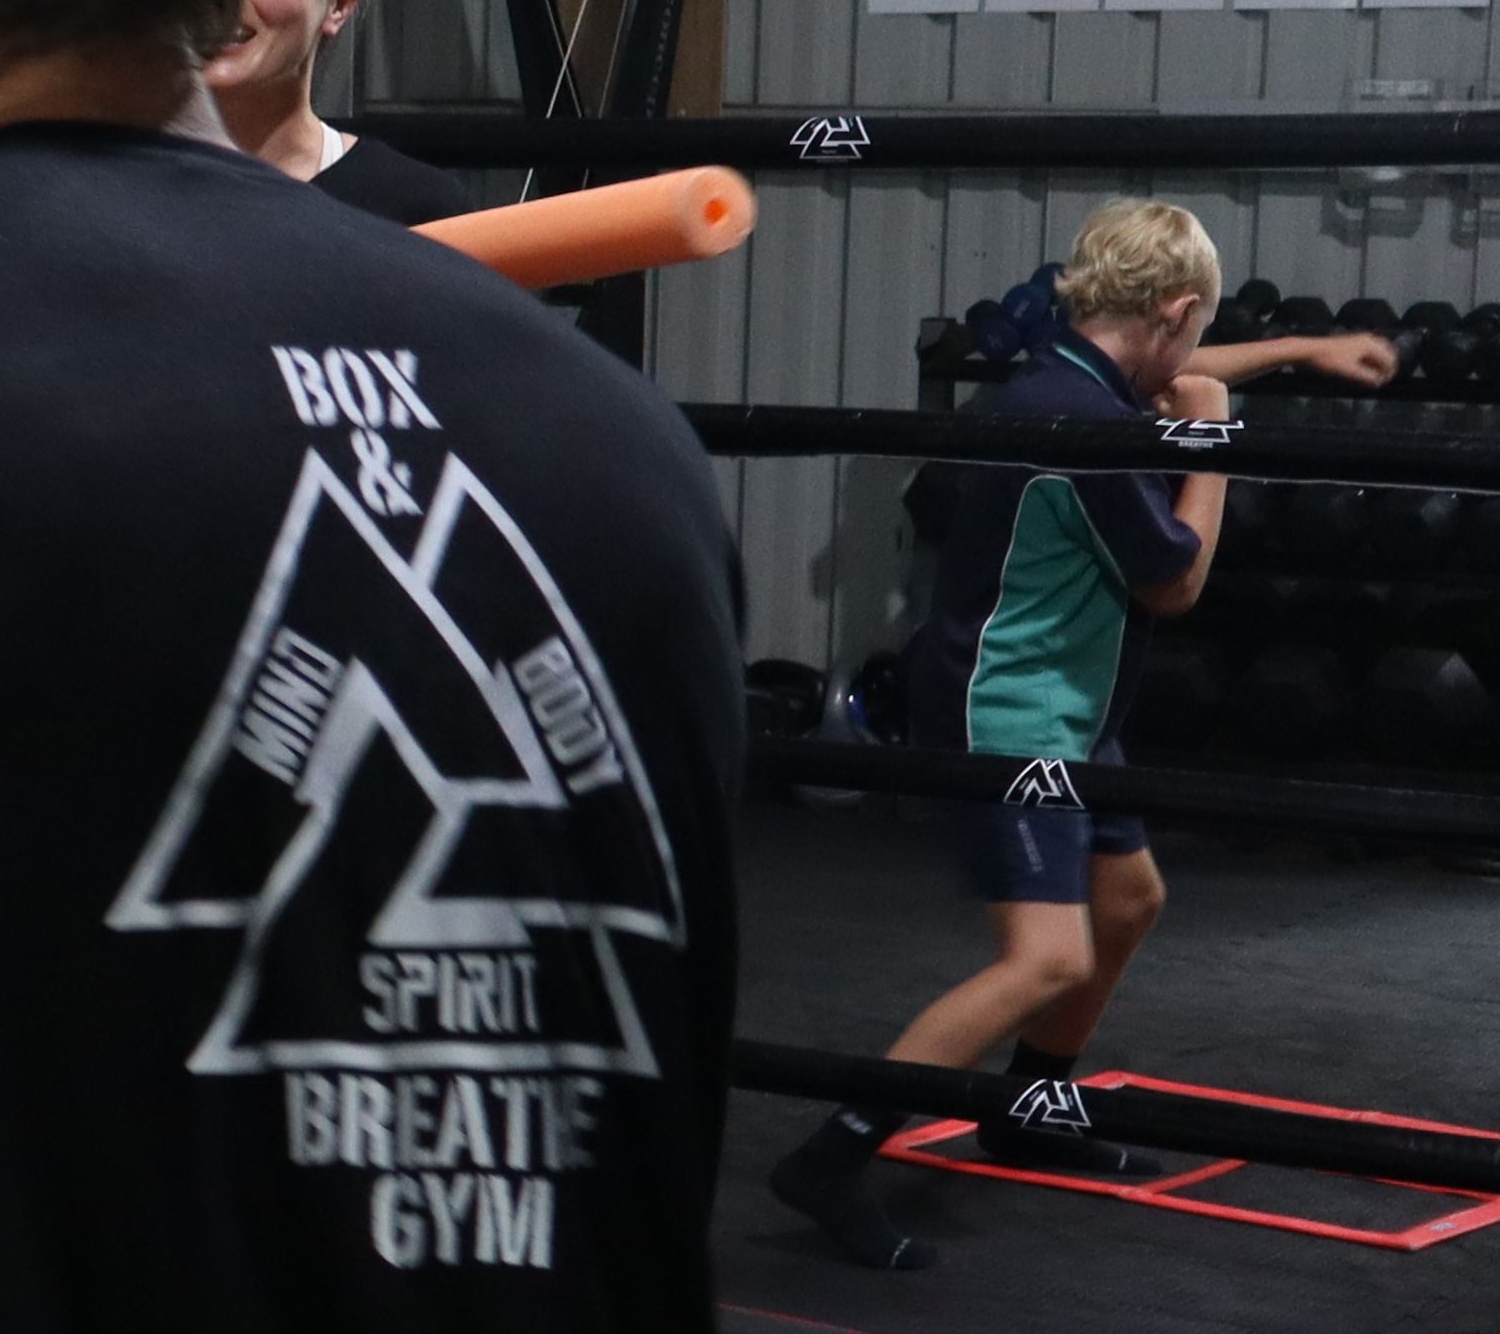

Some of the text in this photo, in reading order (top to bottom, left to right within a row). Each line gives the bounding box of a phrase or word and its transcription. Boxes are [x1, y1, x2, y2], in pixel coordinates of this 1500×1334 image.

[271, 346, 442, 430] BOX
[351, 425, 424, 517] &
[233, 627, 350, 788] MIND
[514, 637, 624, 794] BODY
[360, 952, 541, 1034] SPIRIT
[370, 1174, 553, 1269] GYM
